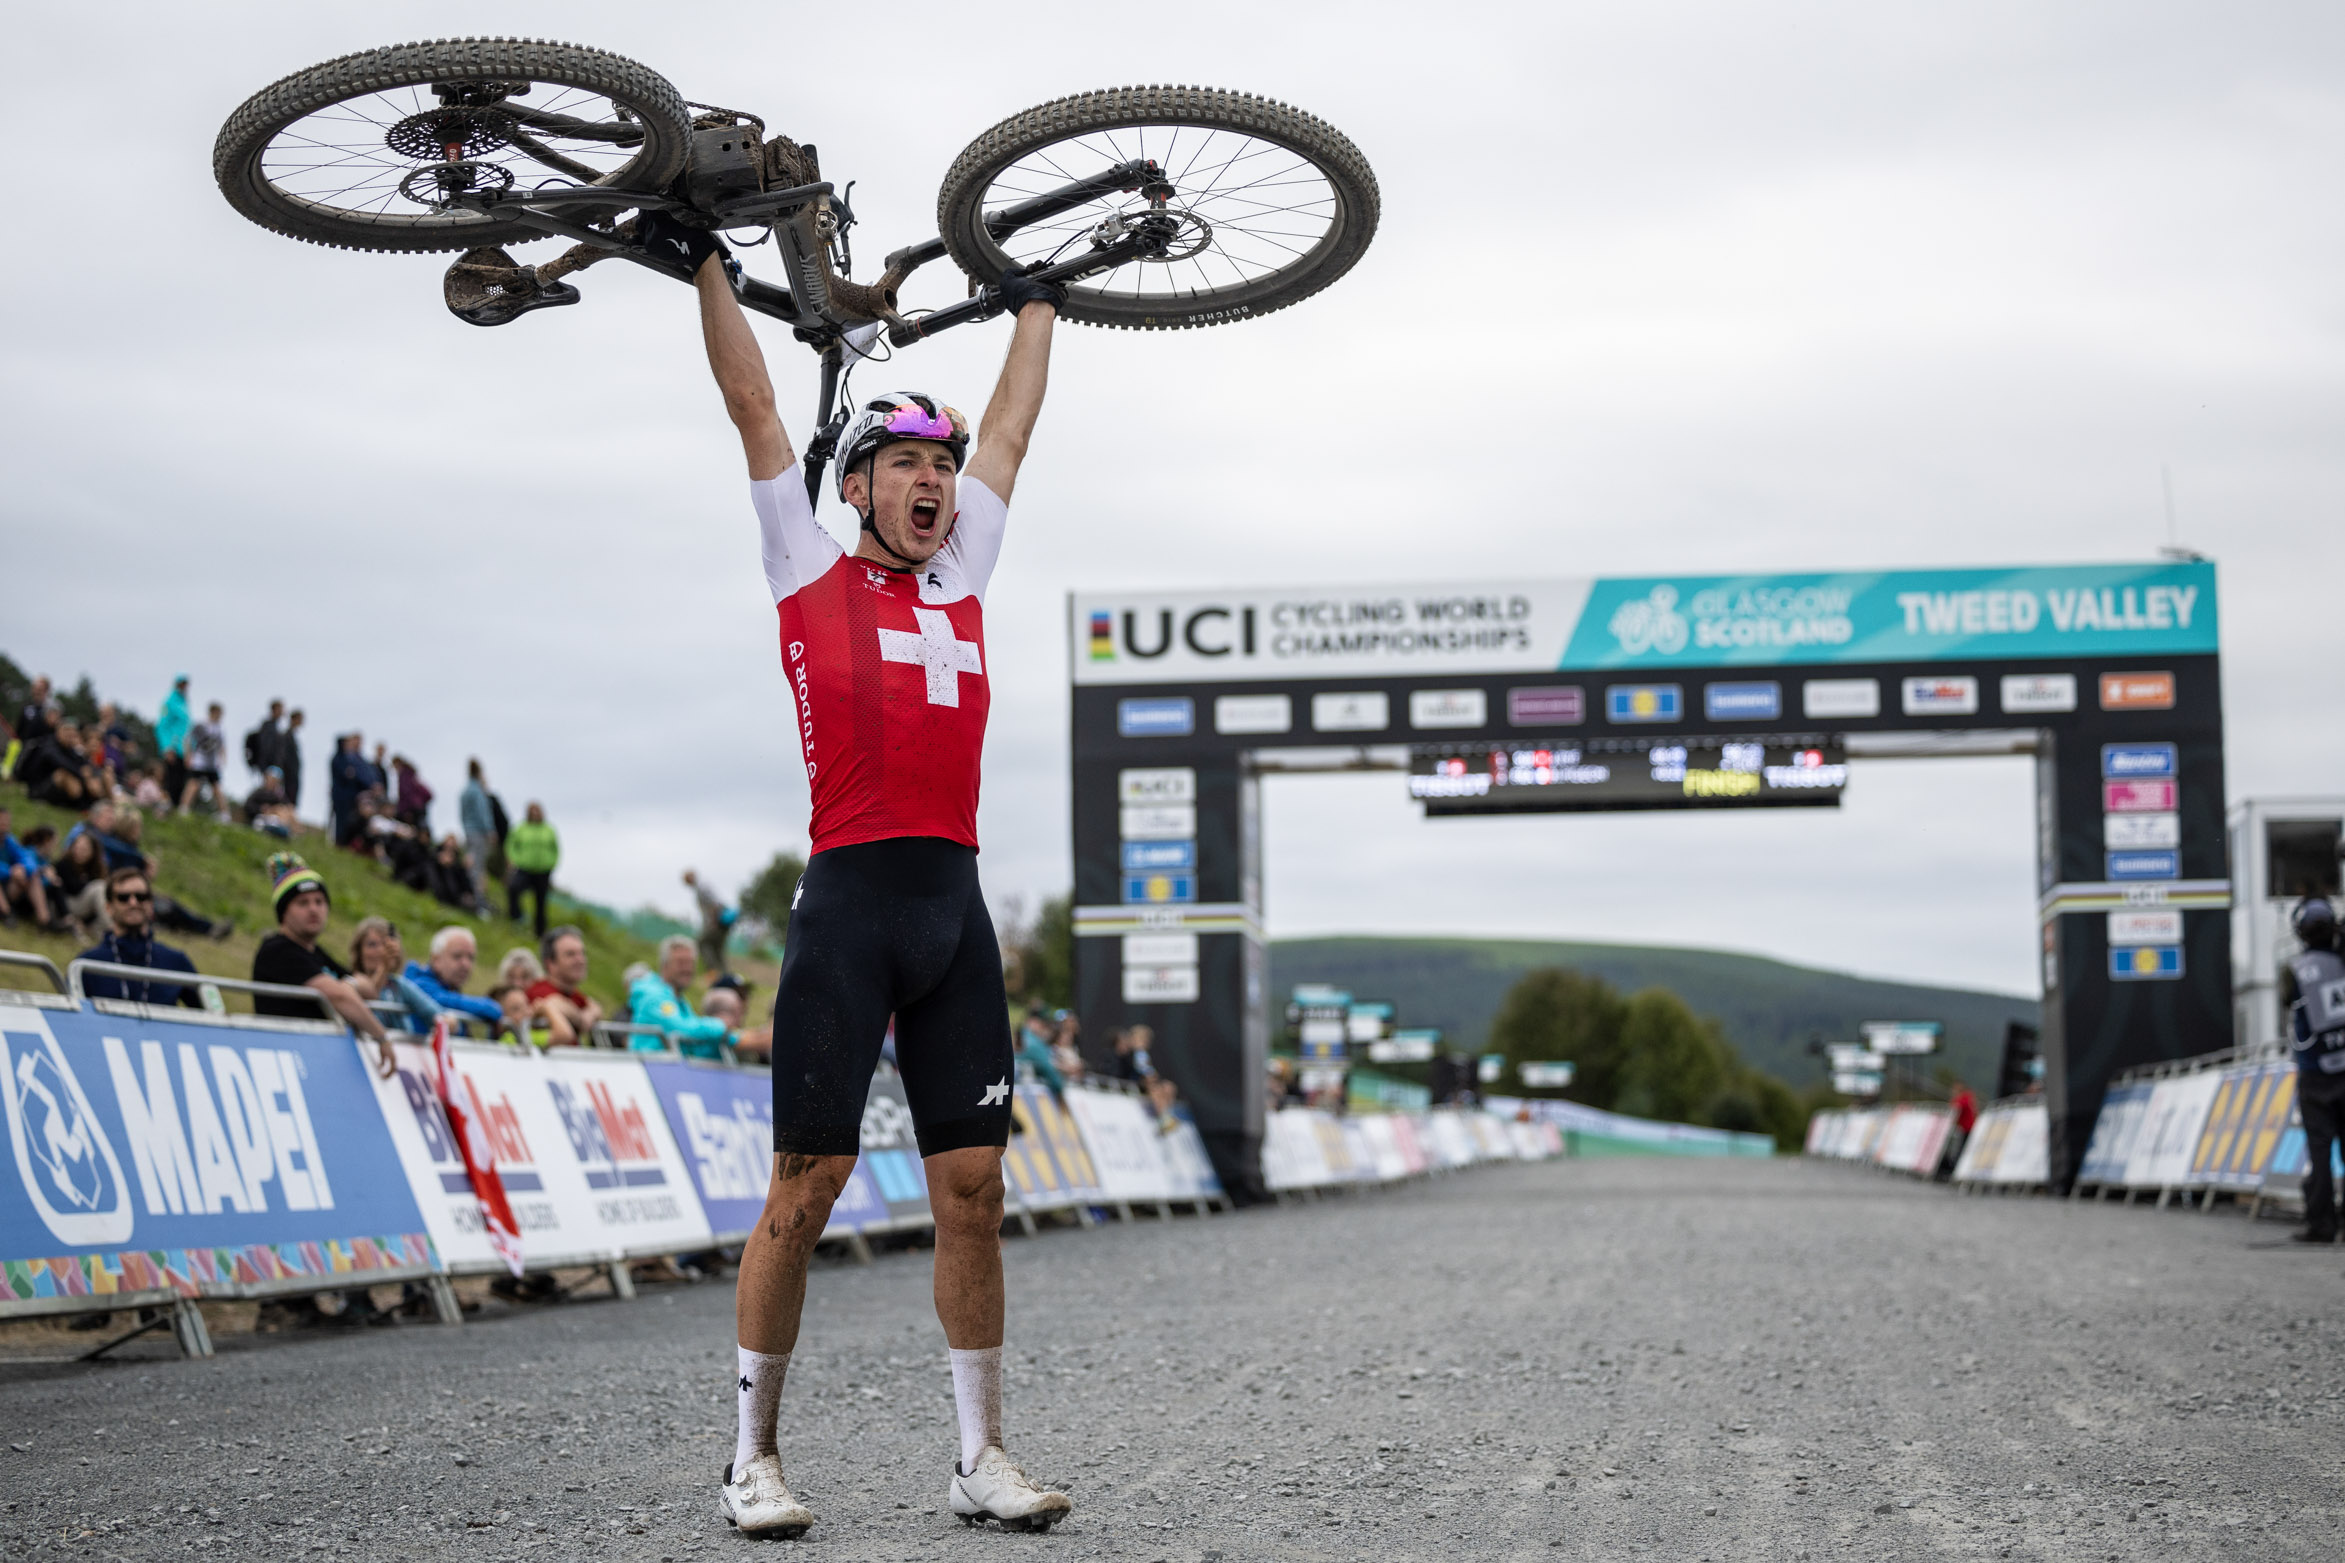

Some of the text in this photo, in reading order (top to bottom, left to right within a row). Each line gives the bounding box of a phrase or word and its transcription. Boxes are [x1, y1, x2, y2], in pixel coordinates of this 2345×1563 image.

[1188, 305, 1250, 323] BUTCHER
[1122, 596, 1530, 659] UCI CYCLING WORLD
[1694, 614, 1853, 648] SCOTLAND
[1896, 584, 2198, 635] TWEED VALLEY
[1271, 625, 1530, 658] CHAMPIONSHIPS
[795, 661, 815, 757] TUDOR
[102, 1036, 336, 1215] MAPEI
[398, 1069, 534, 1163] Biat
[675, 1091, 773, 1200] Santi
